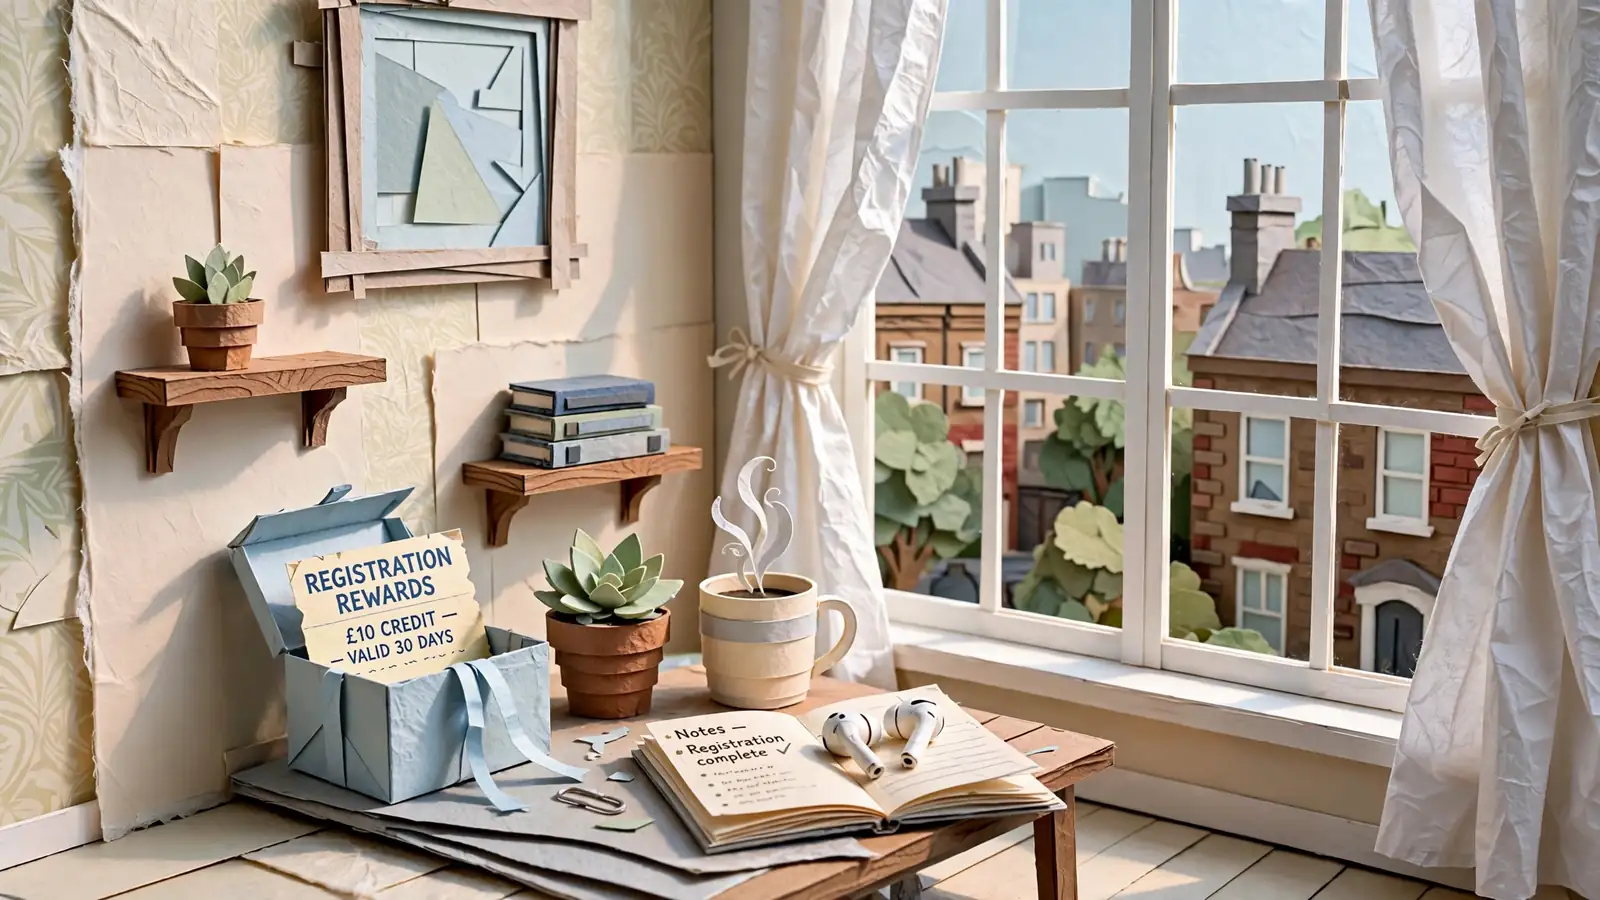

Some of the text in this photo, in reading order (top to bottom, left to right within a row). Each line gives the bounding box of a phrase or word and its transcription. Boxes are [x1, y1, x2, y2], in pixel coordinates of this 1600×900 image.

[304, 546, 453, 594] REGISTRATION
[335, 575, 435, 614] REWARDS
[346, 624, 375, 645] £10
[380, 611, 436, 637] CREDIT
[347, 644, 390, 665] VALID
[394, 638, 413, 654] 30
[417, 629, 454, 649] DAYS
[674, 725, 726, 740] Notes
[686, 734, 785, 755] Registration
[697, 749, 769, 766] complete
